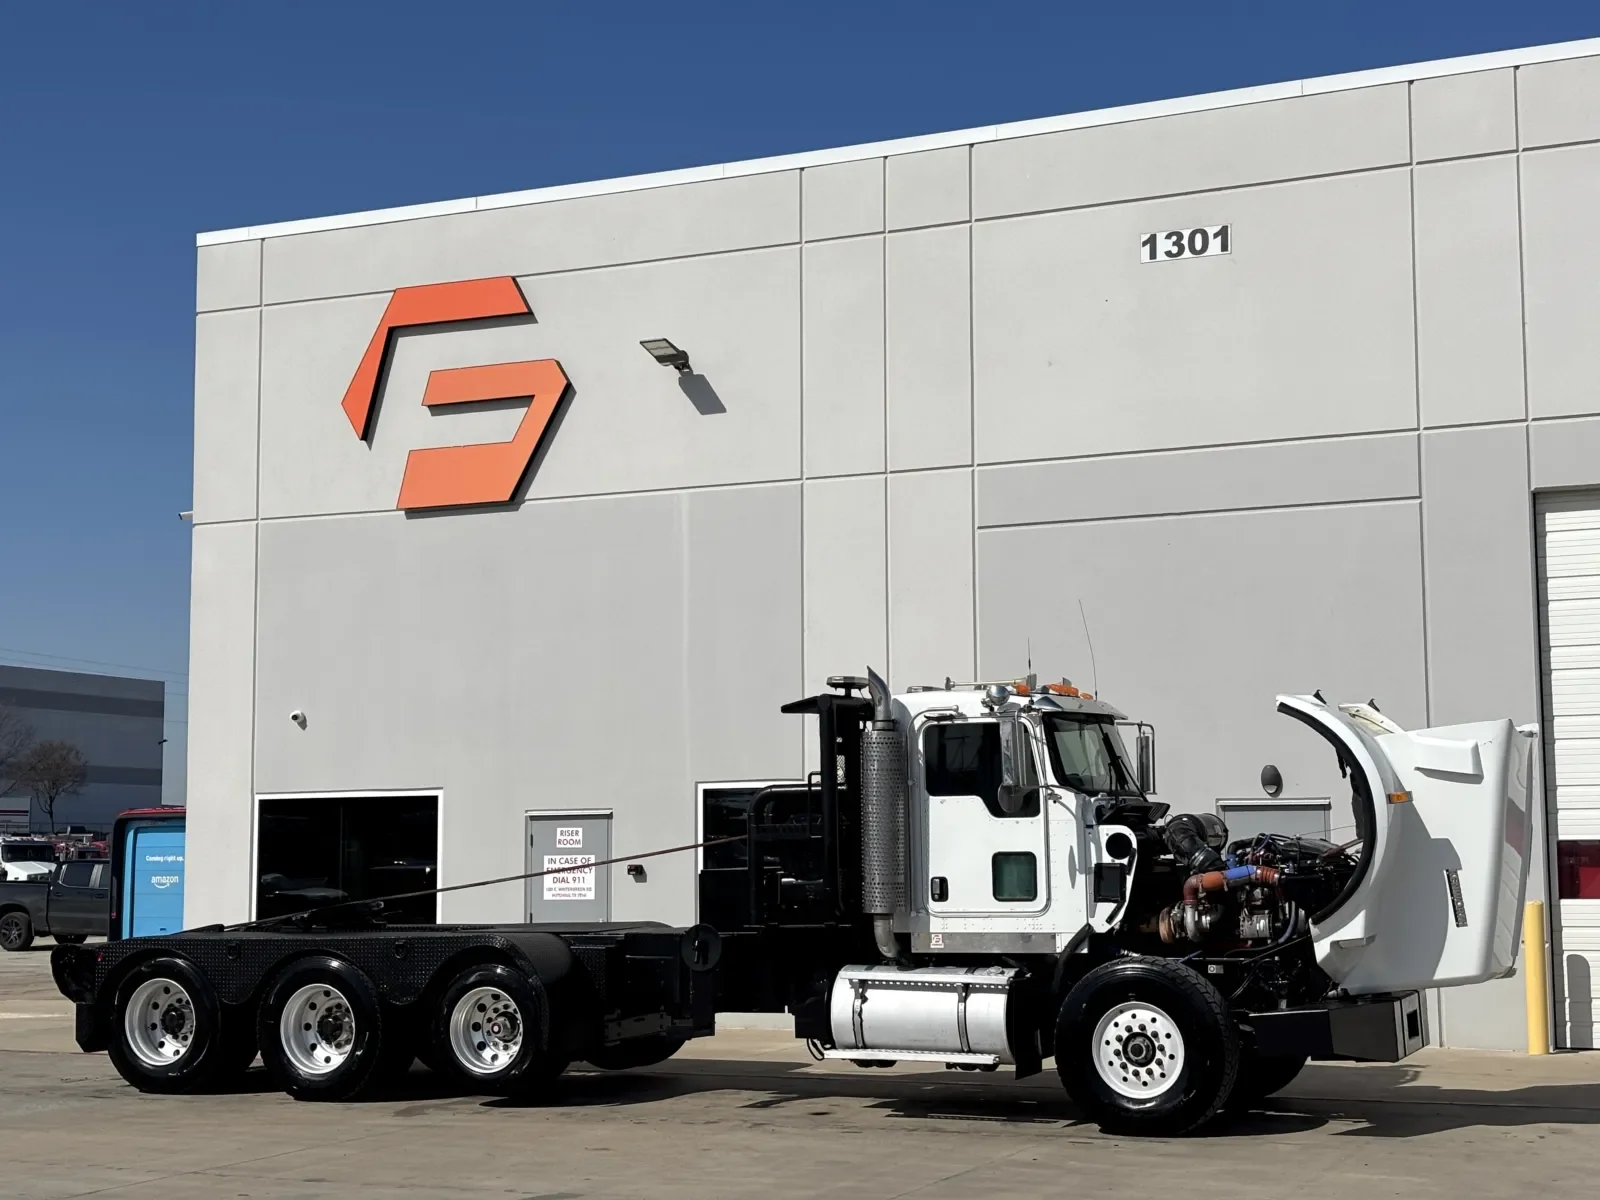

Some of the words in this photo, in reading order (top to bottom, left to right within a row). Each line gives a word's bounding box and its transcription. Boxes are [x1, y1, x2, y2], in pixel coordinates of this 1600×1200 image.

[1141, 225, 1229, 260] 1301
[145, 855, 164, 863] Coming
[164, 855, 176, 863] right
